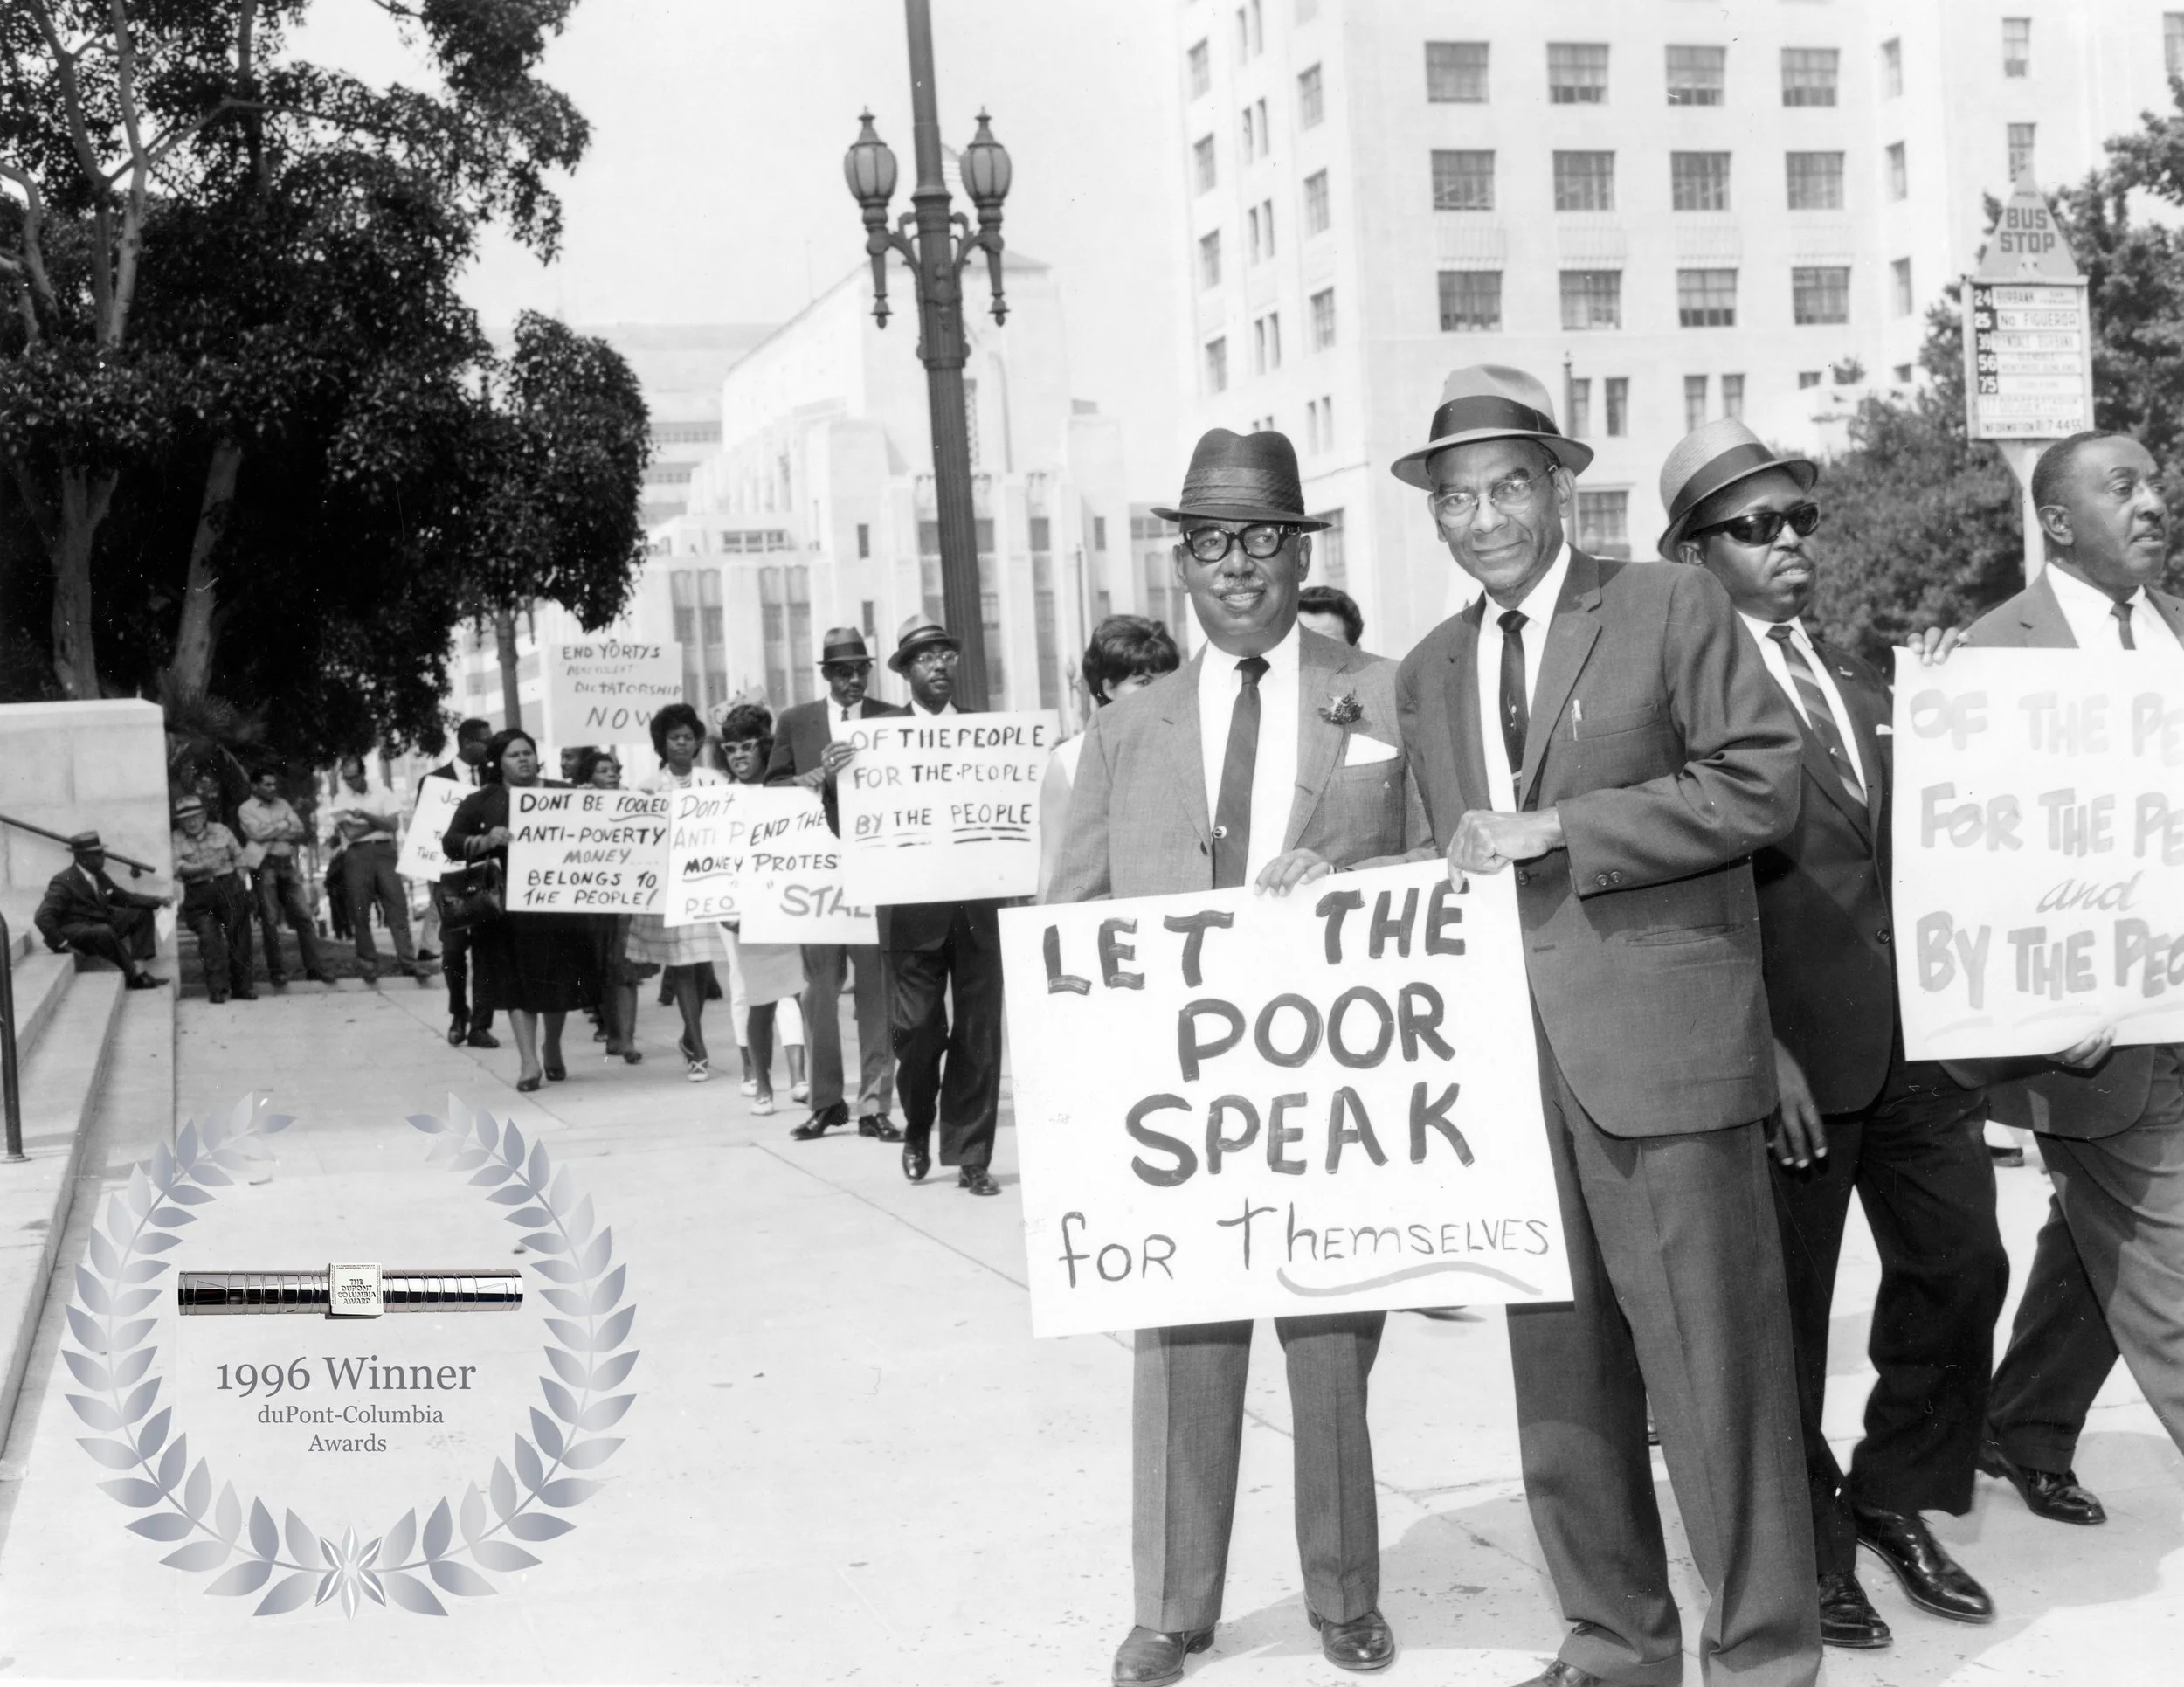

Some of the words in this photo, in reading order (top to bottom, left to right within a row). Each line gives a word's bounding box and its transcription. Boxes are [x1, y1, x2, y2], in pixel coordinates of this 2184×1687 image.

[2007, 208, 2048, 229] BUS
[2000, 232, 2055, 253] STOP
[1974, 289, 1992, 307] 24
[1979, 354, 1997, 372] 56
[1979, 376, 1998, 393] 75
[563, 646, 593, 660] END
[575, 681, 681, 697] DICTATORSHIP
[586, 705, 653, 729] NOW
[1910, 688, 1988, 751] OF
[2018, 690, 2110, 757] THE
[851, 729, 890, 751] OF
[898, 728, 951, 748] THE
[958, 725, 1044, 748] PEOPLE
[853, 765, 902, 789] FOR
[911, 764, 953, 782] THE
[961, 764, 1038, 782] PEOPLE
[520, 793, 573, 812] DONT
[583, 793, 605, 812] BE
[615, 794, 669, 814] FOOLED
[855, 812, 883, 835] BY
[894, 808, 932, 826] THE
[951, 804, 1032, 824] PEOPLE
[1920, 781, 2025, 852] FOR
[2038, 787, 2116, 858] THE
[517, 826, 667, 844] ANTI-POVERTY
[750, 818, 791, 847] END
[418, 846, 439, 861] THE
[751, 853, 841, 873] PROTES
[683, 856, 744, 875] MONEY
[528, 871, 622, 887] BELONGS
[637, 872, 658, 888] TO
[523, 888, 561, 905] THE
[574, 888, 659, 909] PEOPLE!
[2036, 870, 2145, 914] and
[685, 895, 736, 915] PEO
[1043, 909, 1234, 995] LET
[1316, 877, 1469, 965] THE
[1916, 910, 1992, 1011] BY
[2007, 925, 2098, 1001] THE
[1178, 981, 1455, 1082] POOR
[1125, 1082, 1476, 1187] SPEAK
